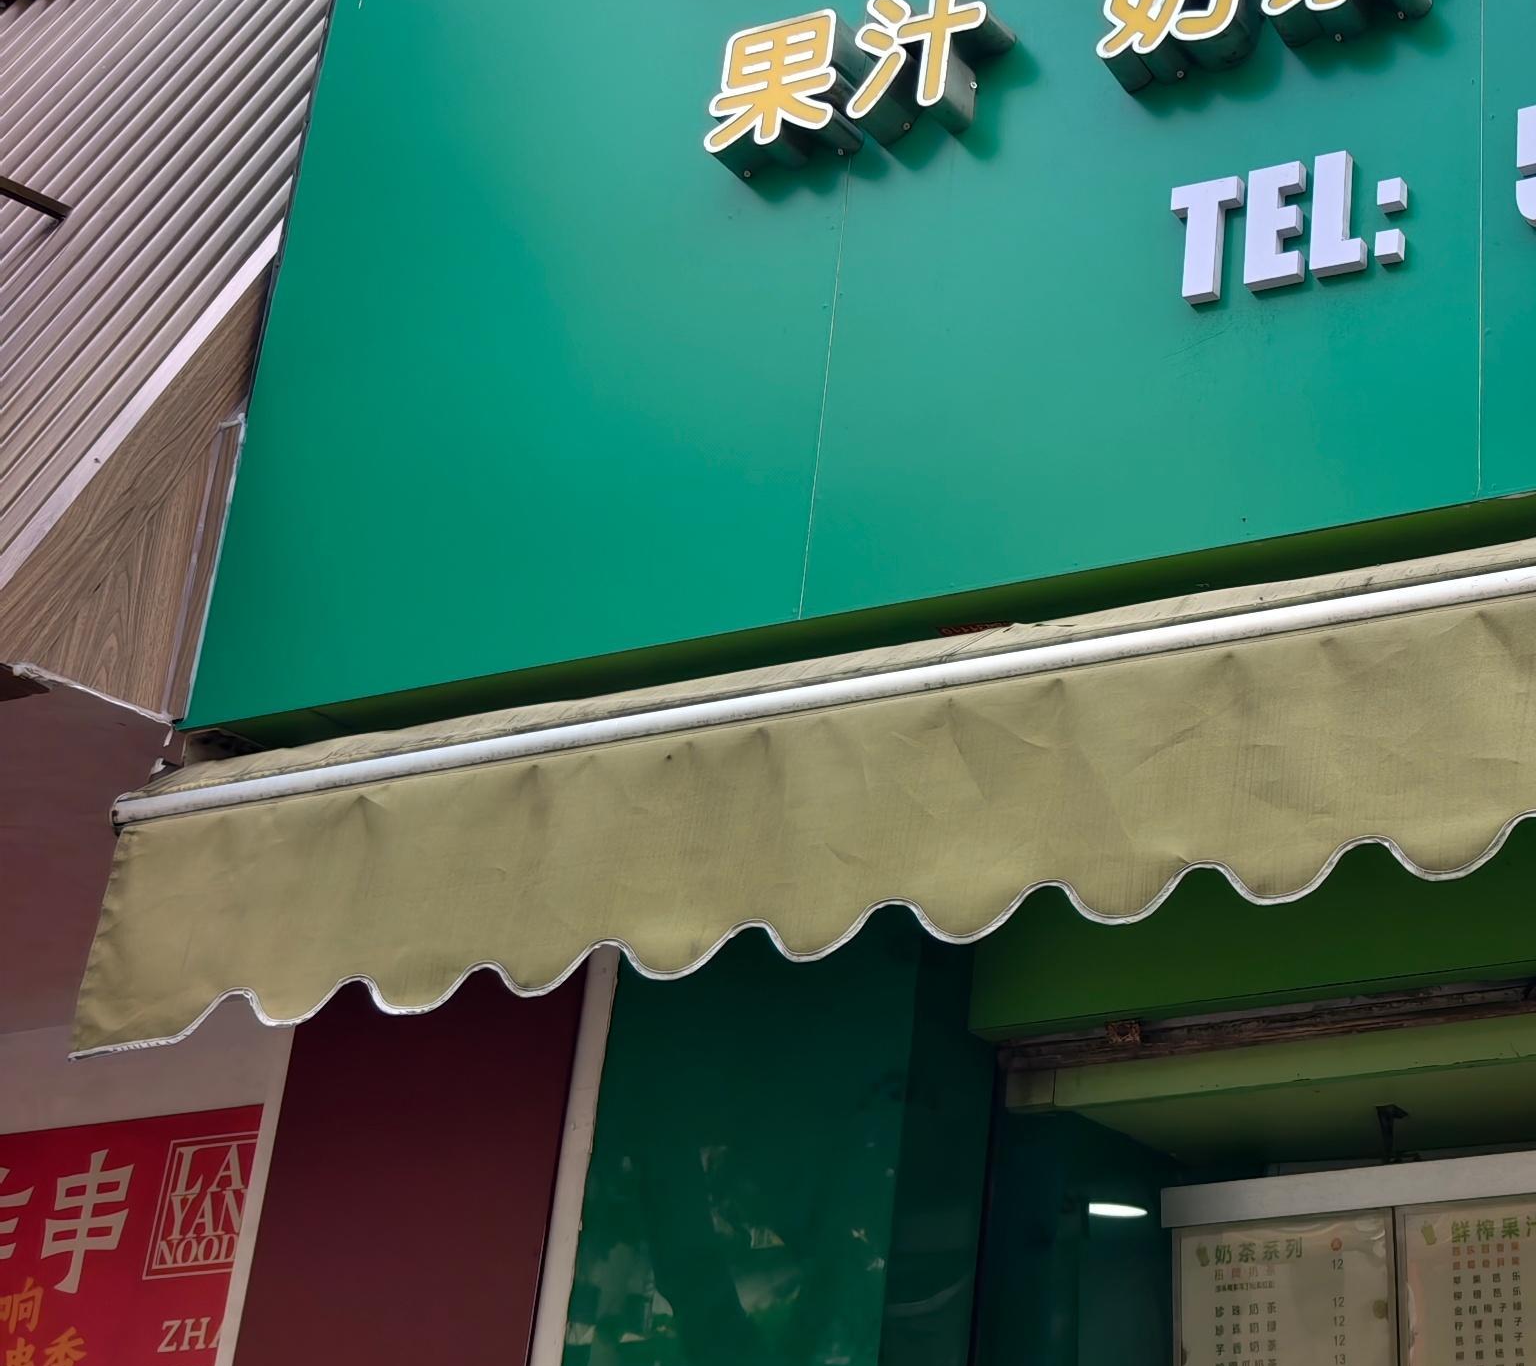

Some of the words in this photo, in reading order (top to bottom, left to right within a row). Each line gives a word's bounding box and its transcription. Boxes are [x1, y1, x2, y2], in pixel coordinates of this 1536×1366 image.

[1169, 150, 1411, 307] TEL:
[1214, 1235, 1304, 1265] 奶茶系列
